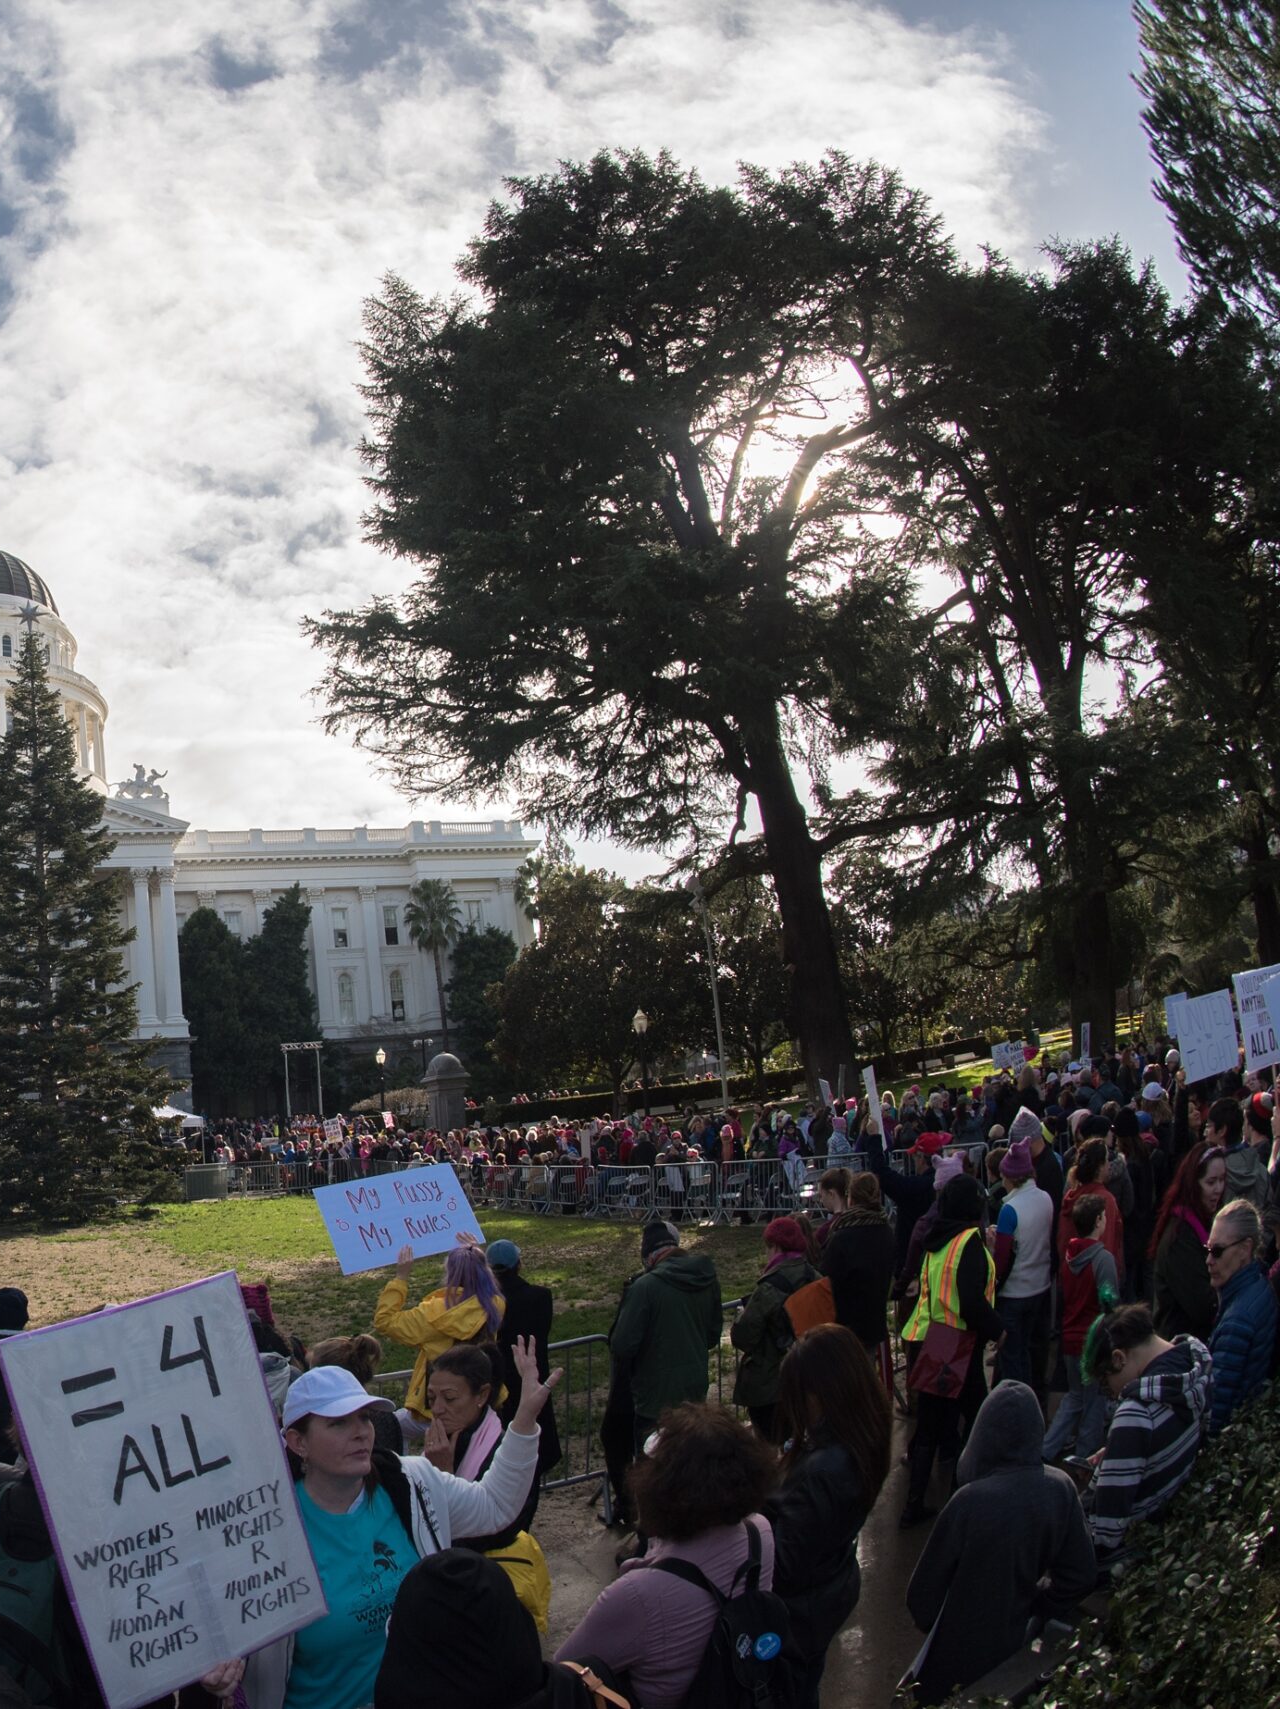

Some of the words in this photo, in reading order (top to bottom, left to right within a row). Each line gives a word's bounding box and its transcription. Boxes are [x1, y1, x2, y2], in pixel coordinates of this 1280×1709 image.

[1251, 1030, 1268, 1059] ALL
[345, 1186, 381, 1214] My
[393, 1180, 444, 1205] Pussy
[358, 1221, 393, 1252] My
[403, 1213, 451, 1239] Rules
[160, 1315, 222, 1398] 4
[113, 1413, 232, 1506] ALL
[195, 1479, 280, 1531] MINORITY
[73, 1522, 174, 1571] WOMENS
[222, 1508, 284, 1547] RIGHTS
[108, 1546, 179, 1588] RIGHTS
[251, 1540, 270, 1564] R
[136, 1583, 160, 1610] R
[225, 1561, 287, 1600] HUMAN
[241, 1577, 311, 1624] RIGHTS
[108, 1600, 185, 1643] HUMAN
[129, 1624, 199, 1668] RIGHTS
